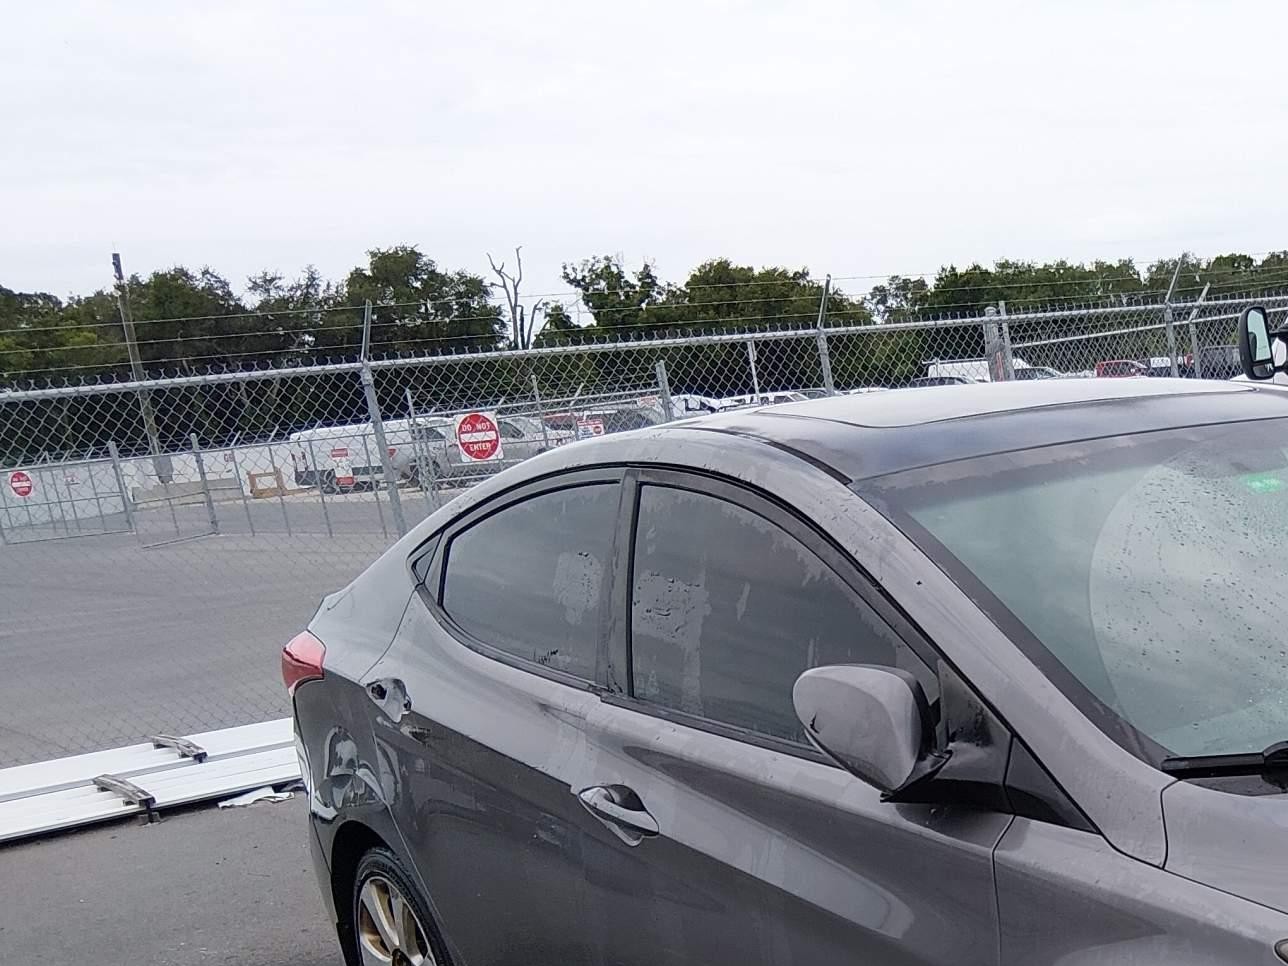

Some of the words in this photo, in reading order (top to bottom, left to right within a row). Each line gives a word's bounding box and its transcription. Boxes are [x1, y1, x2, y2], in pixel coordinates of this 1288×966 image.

[461, 423, 472, 432] DO
[475, 421, 491, 431] NOT
[469, 442, 491, 452] ENTER
